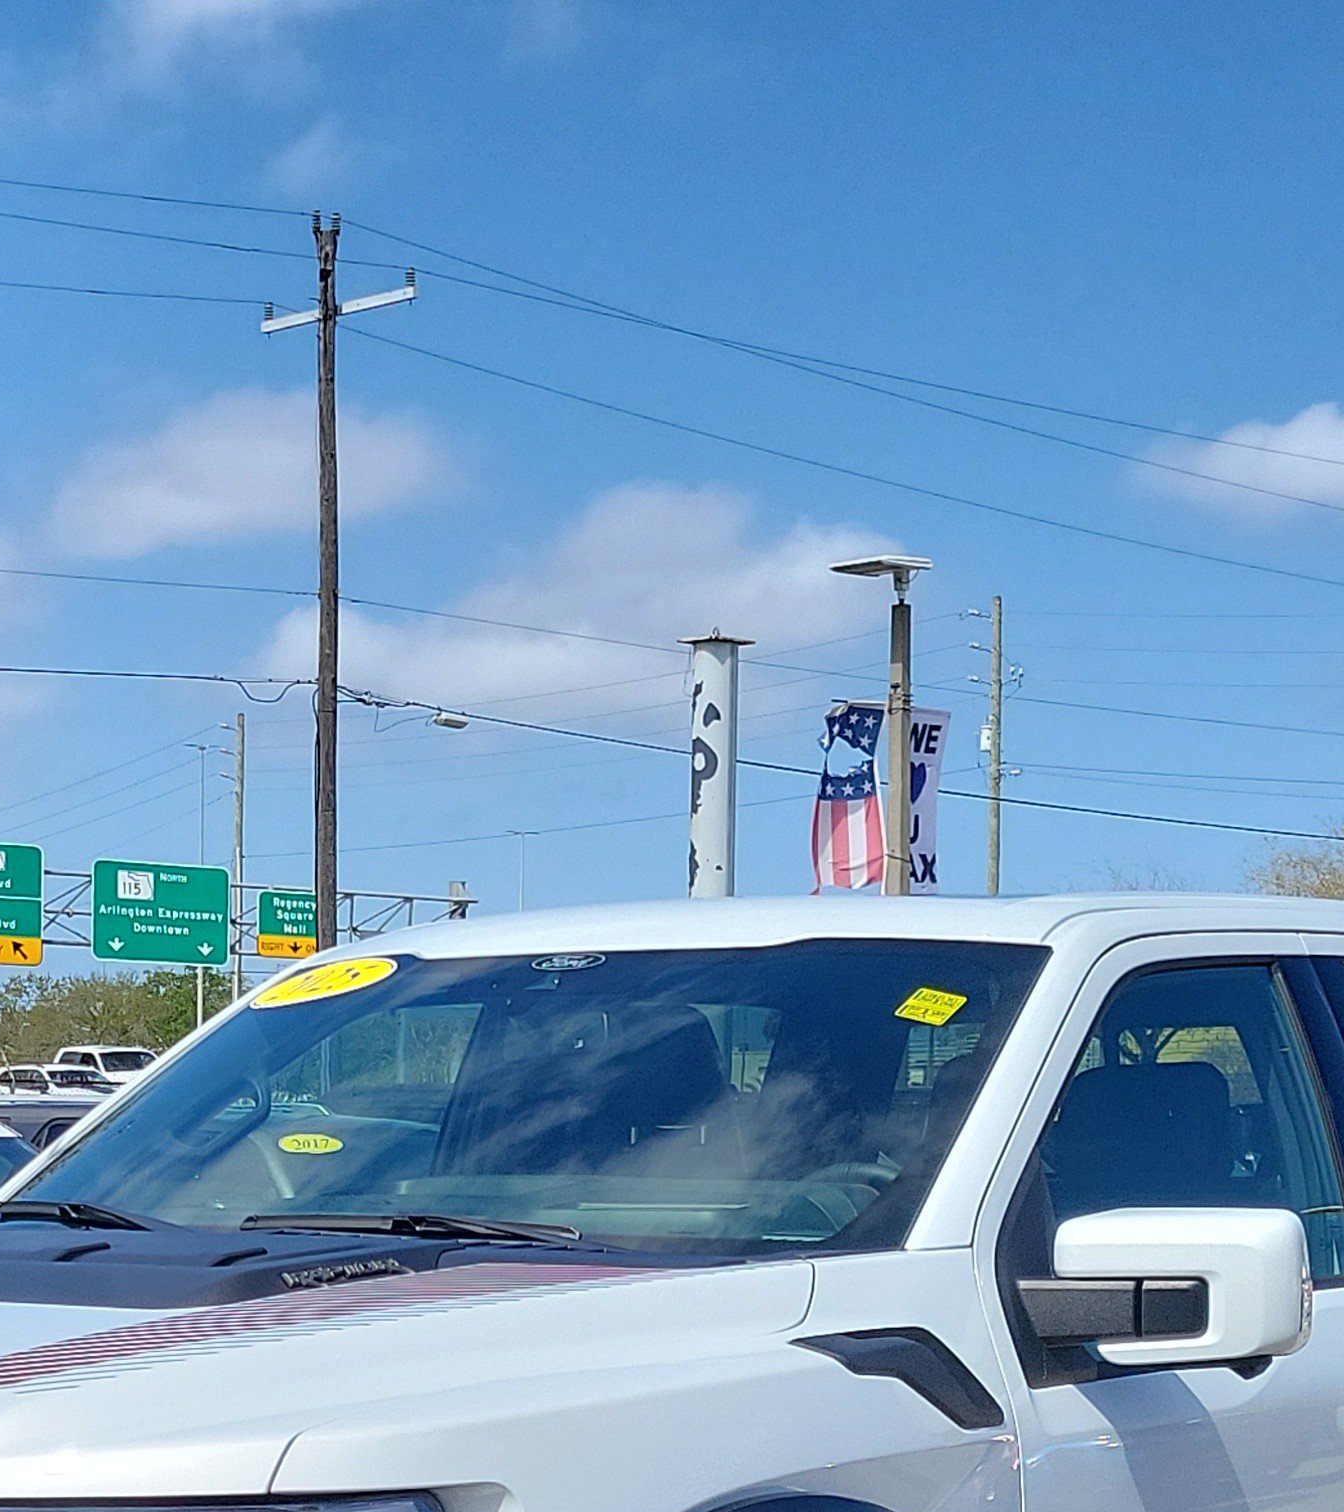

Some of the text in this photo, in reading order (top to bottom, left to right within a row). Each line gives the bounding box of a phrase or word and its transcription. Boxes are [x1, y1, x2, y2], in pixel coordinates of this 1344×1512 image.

[159, 872, 188, 884] NORTH
[122, 881, 142, 895] 115
[273, 896, 317, 912] Regency
[99, 903, 224, 924] Arlington Expressway
[276, 909, 314, 922] Square
[133, 922, 190, 936] Downtown
[283, 923, 307, 935] Mall
[291, 1138, 330, 1151] 2017
